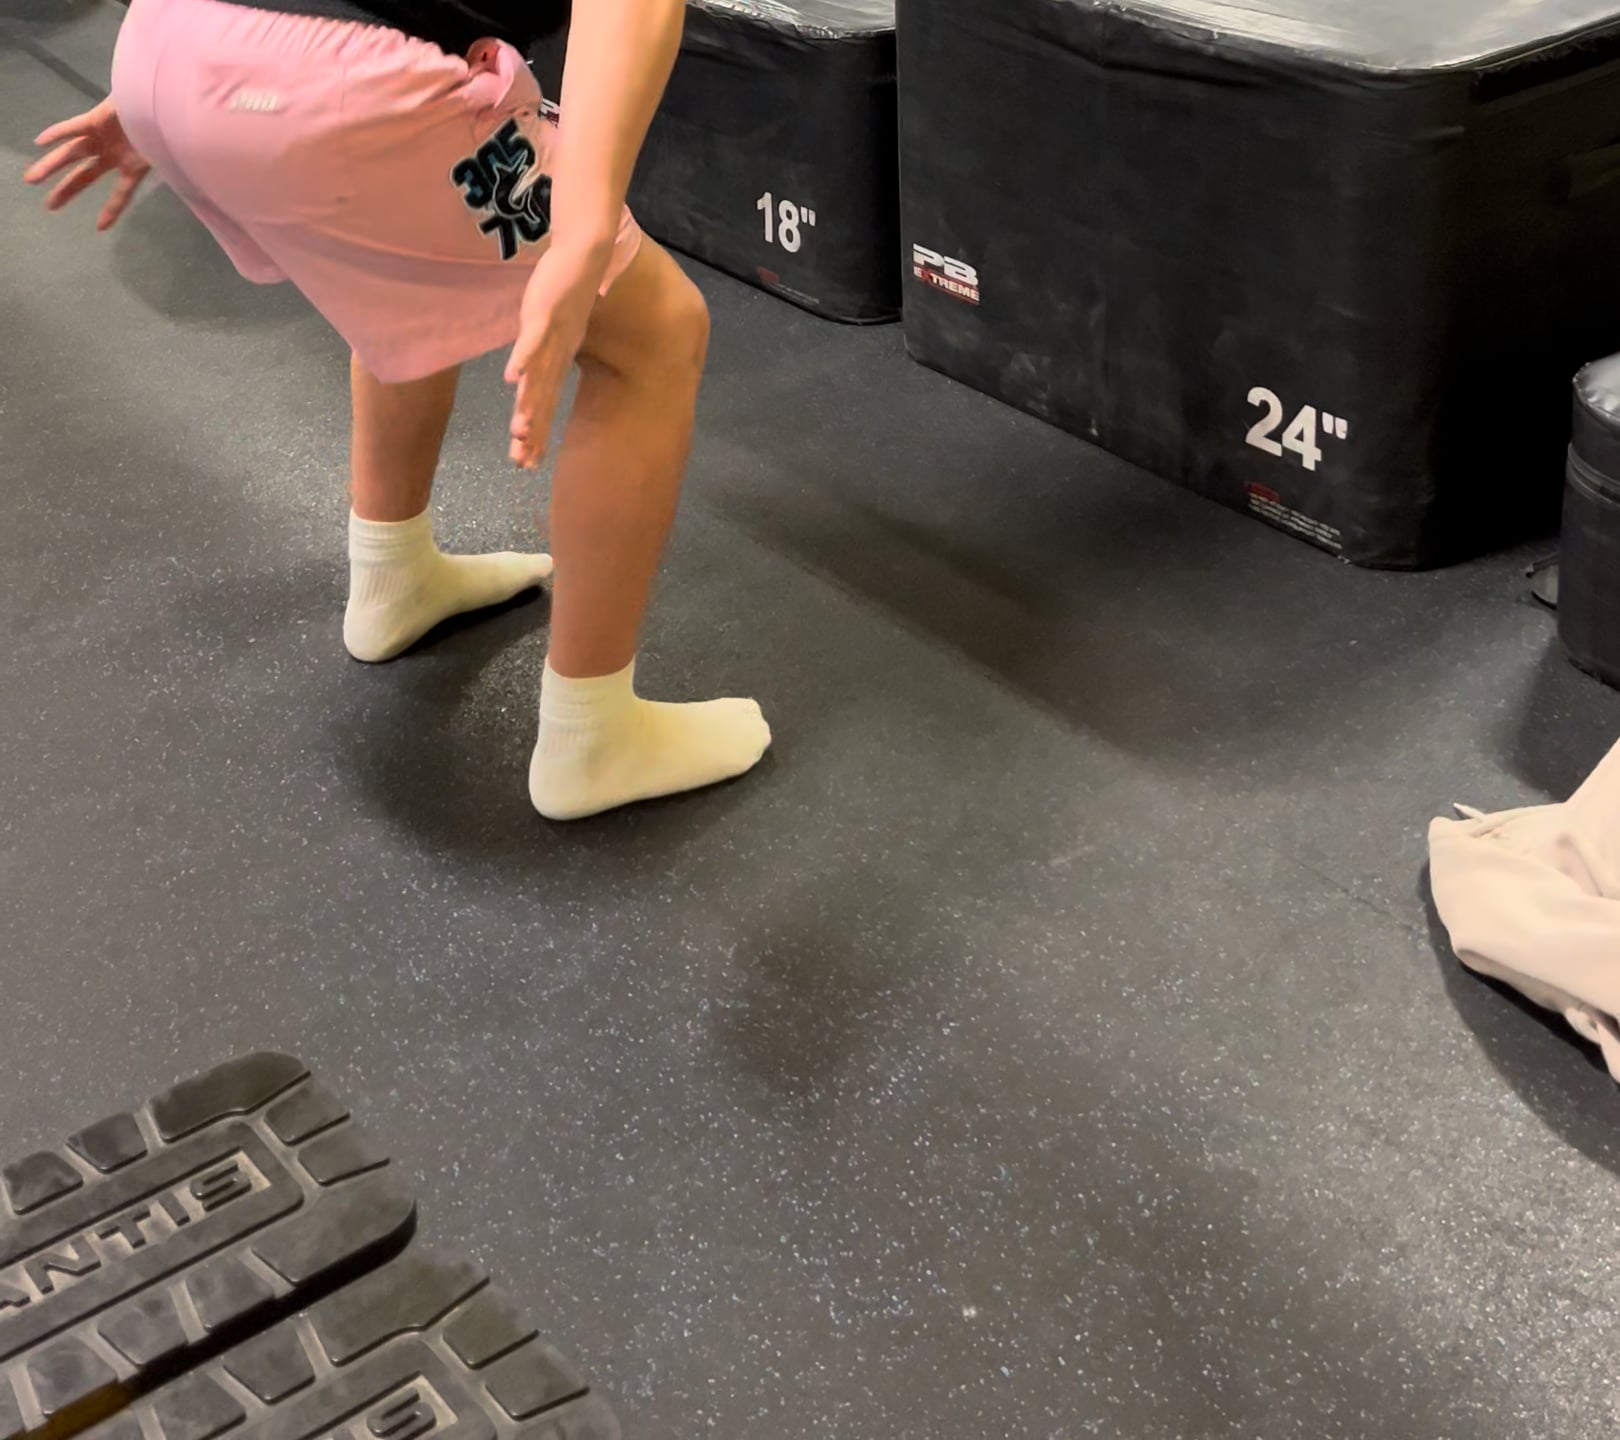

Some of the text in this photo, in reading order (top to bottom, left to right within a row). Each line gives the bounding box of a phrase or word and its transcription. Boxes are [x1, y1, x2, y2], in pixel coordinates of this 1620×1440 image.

[756, 191, 816, 253] 18"
[913, 243, 978, 286] PB
[913, 266, 980, 302] EXTREME
[1245, 386, 1348, 472] 24"
